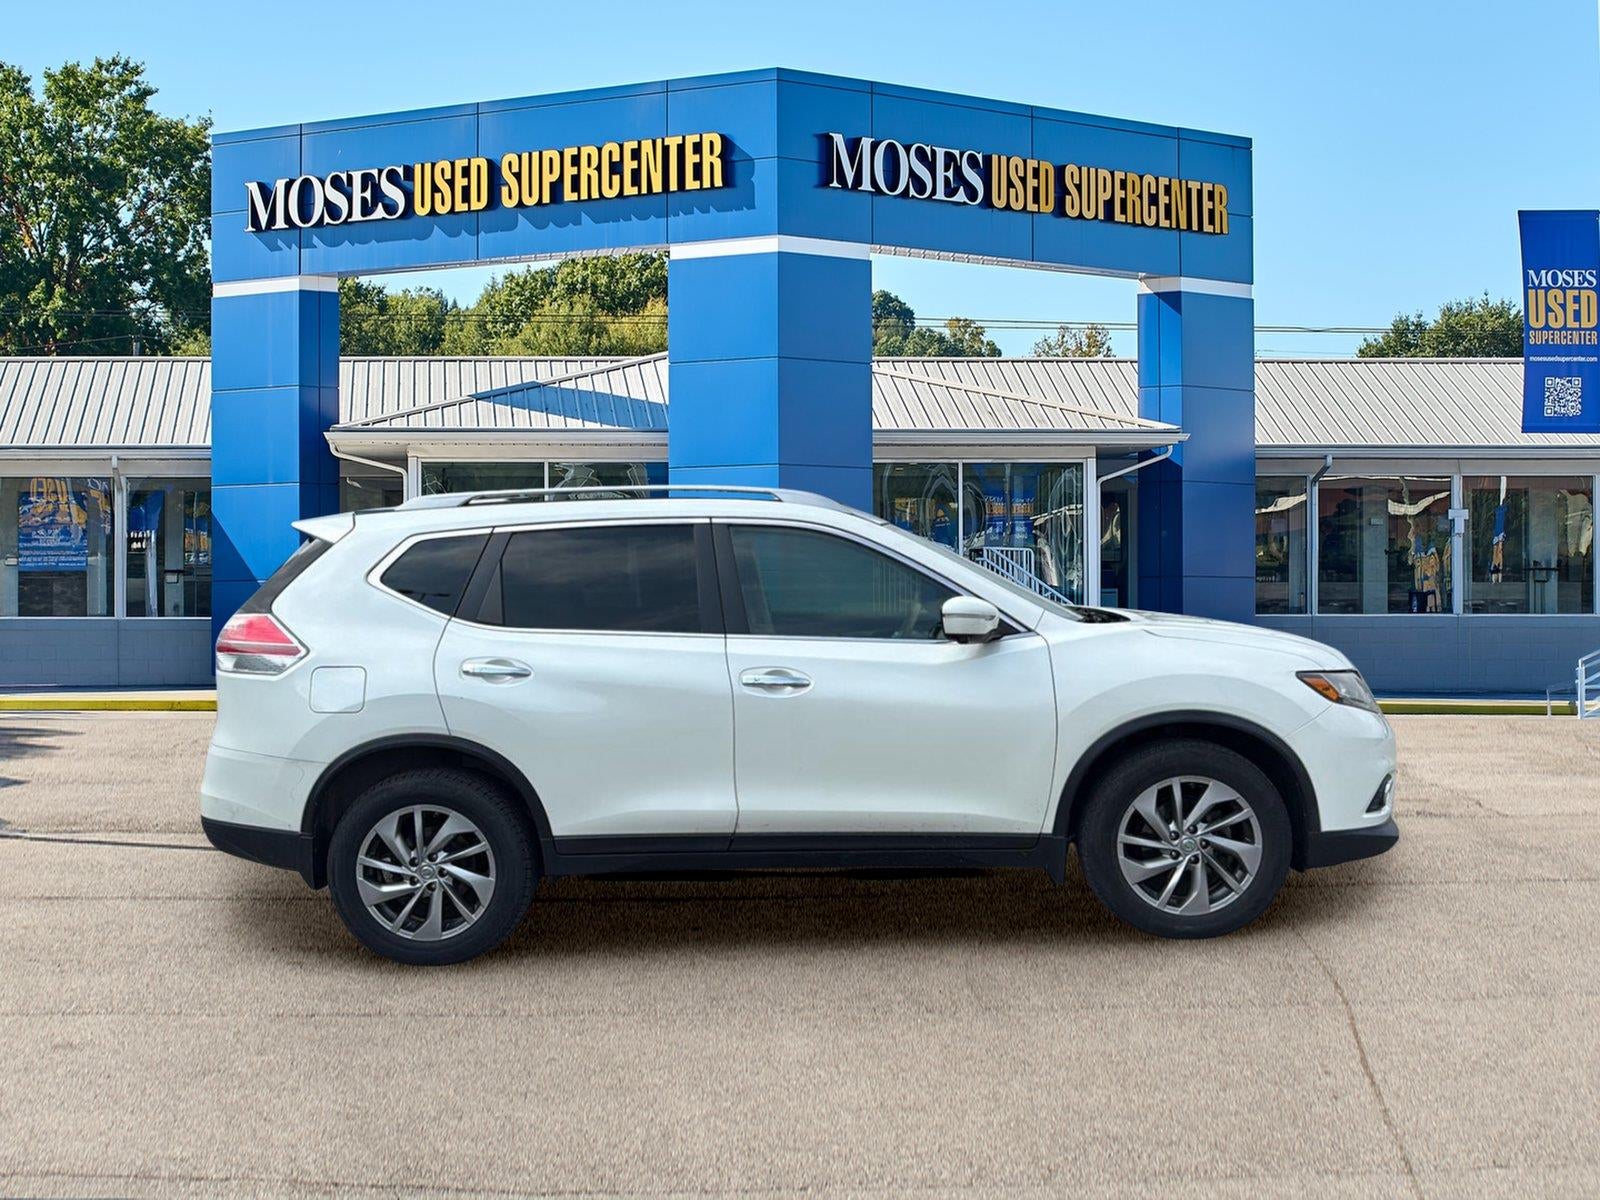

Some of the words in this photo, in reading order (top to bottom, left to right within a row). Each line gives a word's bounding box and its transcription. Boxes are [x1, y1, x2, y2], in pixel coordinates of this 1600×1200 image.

[245, 165, 407, 232] MOSES
[413, 156, 489, 217] USED
[500, 132, 725, 209] SUPERCENTER
[828, 132, 985, 205] MOSES
[991, 153, 1055, 214] USED
[1064, 163, 1229, 235] SUPERCENTER
[1527, 269, 1597, 288] MOSES
[1528, 289, 1598, 329] USED
[1529, 330, 1598, 345] SUPERCENTER
